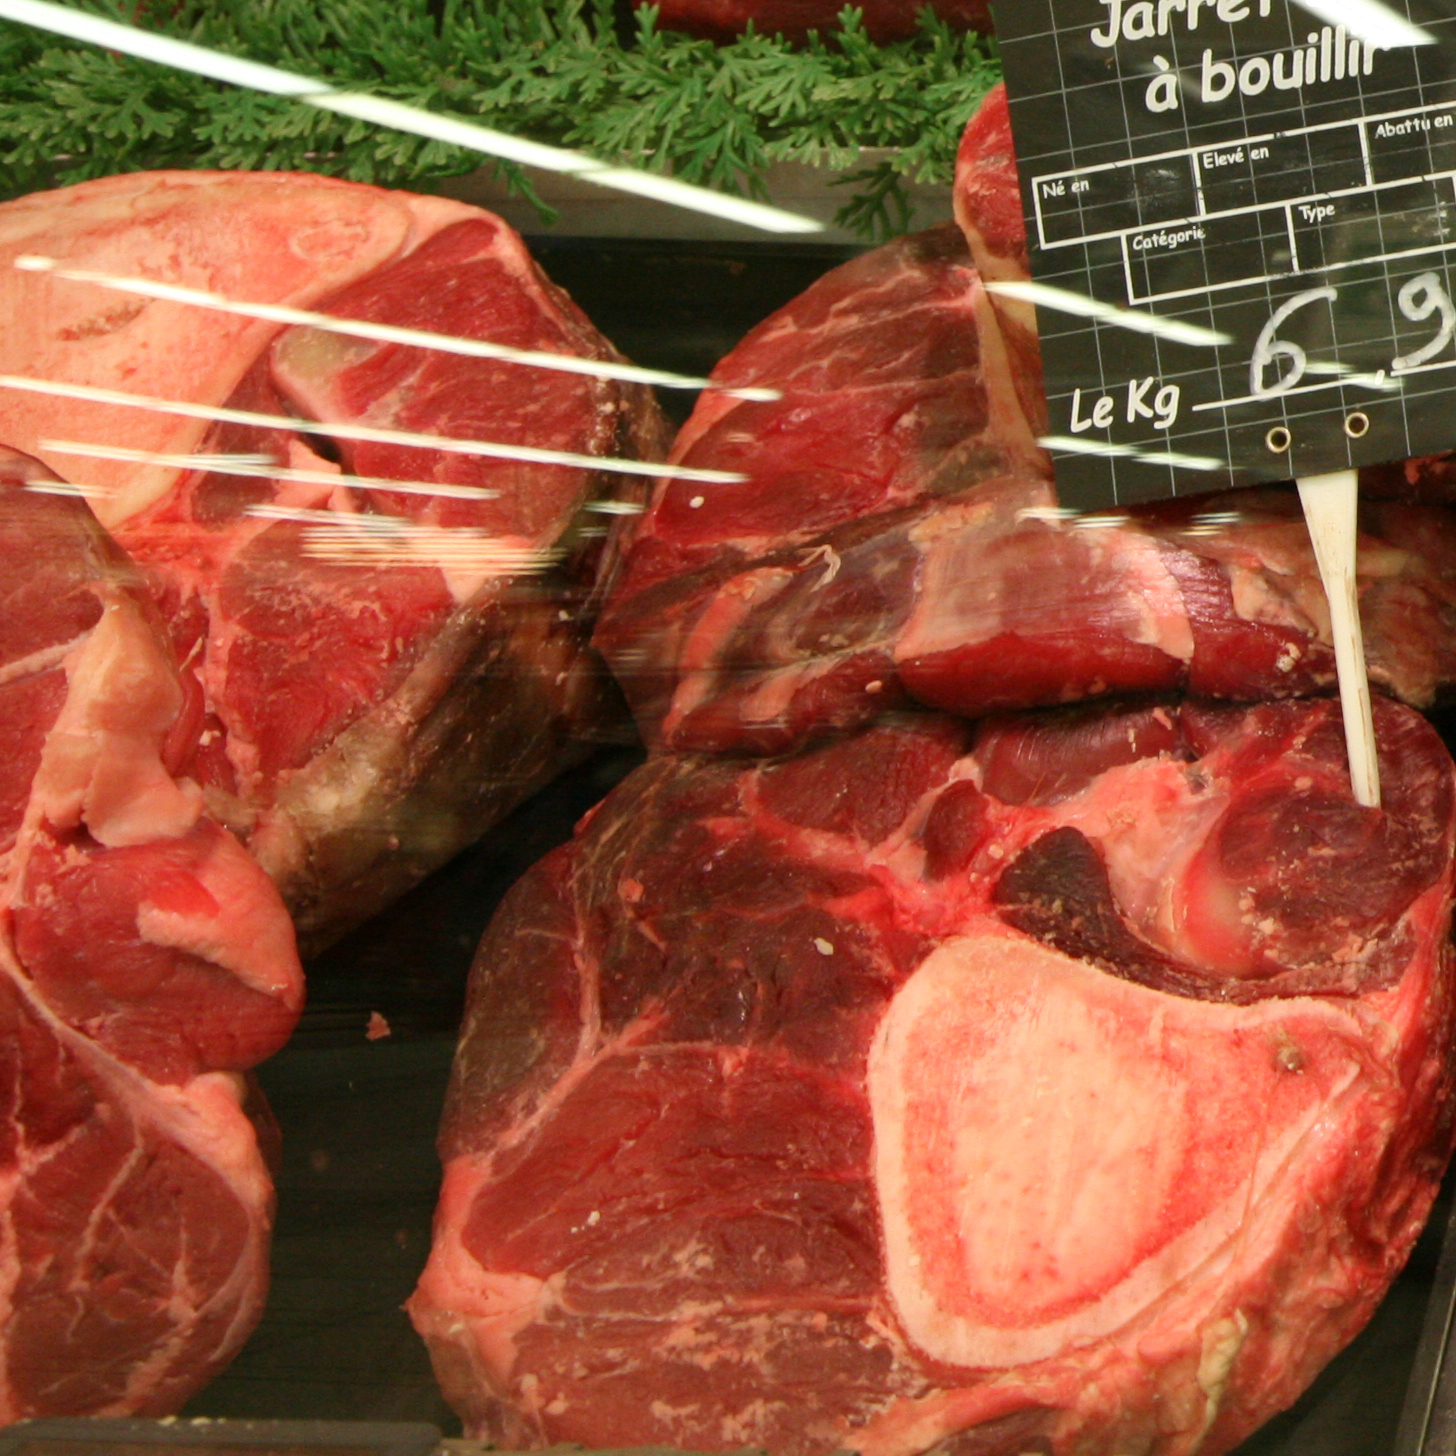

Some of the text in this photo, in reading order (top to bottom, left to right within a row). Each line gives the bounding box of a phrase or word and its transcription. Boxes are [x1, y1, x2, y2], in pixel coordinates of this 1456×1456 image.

[1146, 24, 1391, 113] à bouillir
[1375, 113, 1454, 139] Abattu en
[1202, 145, 1270, 170] Elevé en
[1043, 177, 1090, 200] Né en
[1299, 202, 1336, 221] Type
[1132, 226, 1206, 251] Catégorie
[1070, 388, 1114, 433] Le
[1127, 377, 1181, 430] Kg
